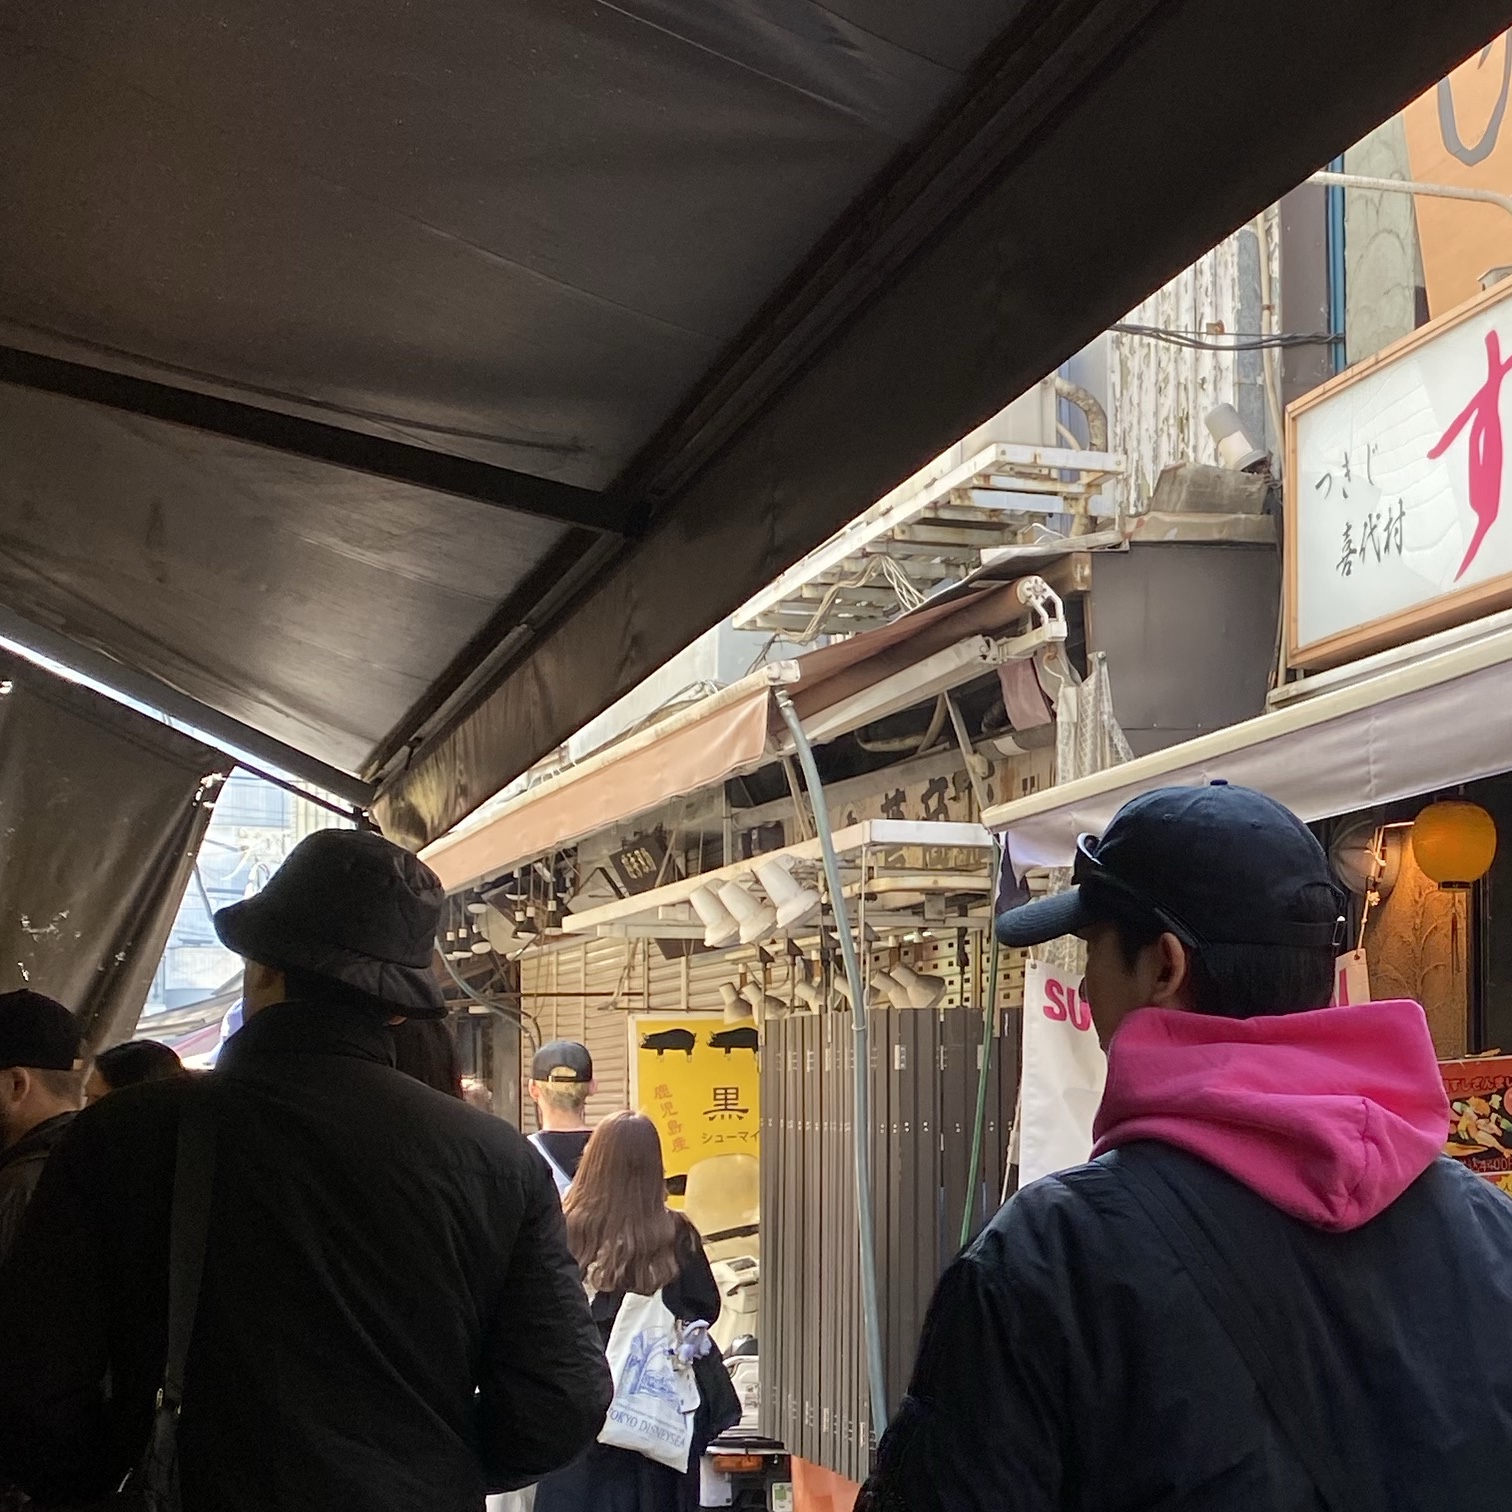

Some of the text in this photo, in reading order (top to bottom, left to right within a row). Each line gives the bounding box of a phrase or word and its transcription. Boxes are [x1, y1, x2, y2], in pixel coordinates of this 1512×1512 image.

[1315, 443, 1378, 500] つきじ
[1336, 497, 1406, 577] 喜代村
[702, 1086, 749, 1121] 黒
